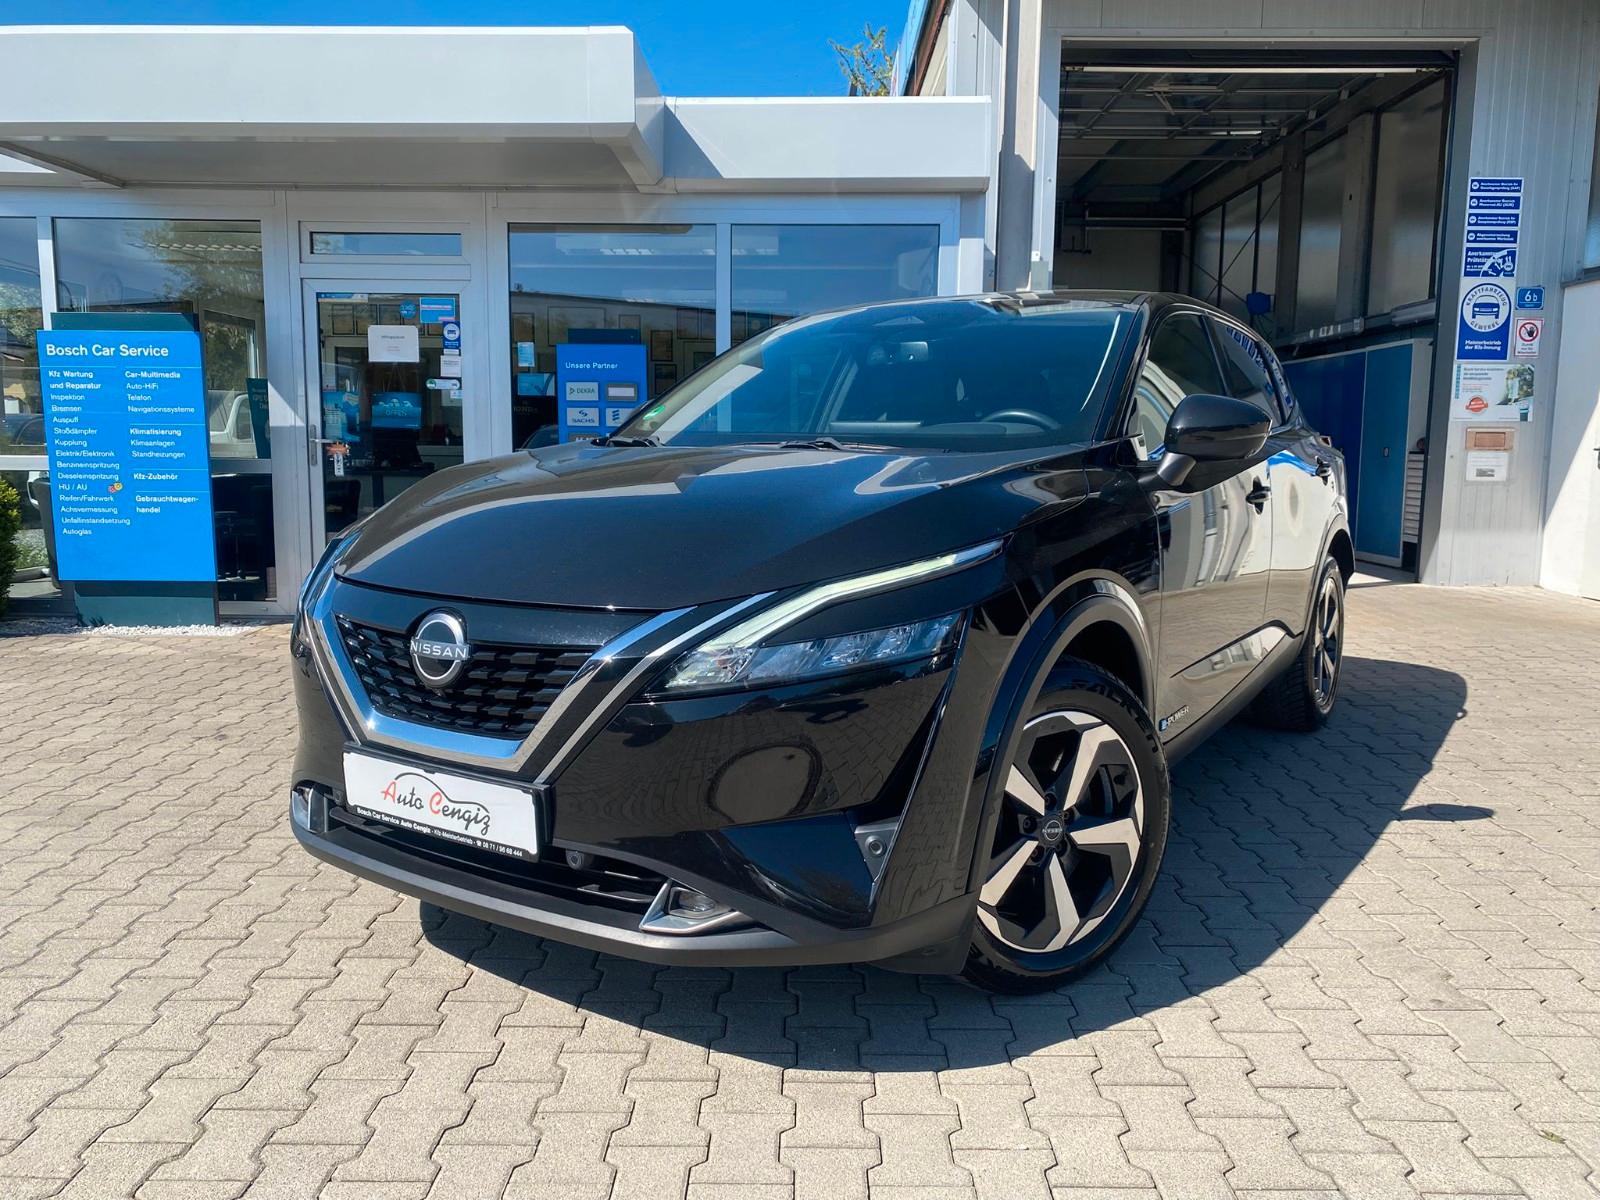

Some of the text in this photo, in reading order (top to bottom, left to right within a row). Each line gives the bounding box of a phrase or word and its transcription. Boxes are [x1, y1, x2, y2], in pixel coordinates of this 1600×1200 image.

[1466, 287, 1507, 306] KRAFTFAHRZEUG
[1470, 320, 1499, 330] GEWERBE
[46, 344, 169, 357] Bosch Car Service
[63, 371, 93, 379] Wartung
[66, 382, 101, 390] Reparatur
[128, 406, 195, 414] Navigationssysteme
[53, 416, 79, 424] Auspuff
[130, 428, 182, 437] Klimatisierung
[54, 439, 87, 447] Kupplung
[132, 451, 185, 459] Standheizungen
[56, 461, 120, 469] Benzineinspritzung
[58, 473, 119, 481] Dieseleinspritzung
[60, 494, 114, 502] Reifen/Fahrwerk
[135, 495, 199, 503] Gebrauchtwagen-
[60, 506, 118, 514] Achsvermessung
[62, 517, 131, 525] Unfallinstandsetzung
[63, 528, 92, 536] Autoglas
[410, 640, 467, 658] NISSAN
[381, 781, 491, 836] Auto Cengiz
[356, 807, 372, 817] Bosch
[382, 814, 400, 825] Service
[400, 820, 413, 829] Auto
[413, 823, 431, 834] Cengiz
[513, 849, 523, 857] 444
